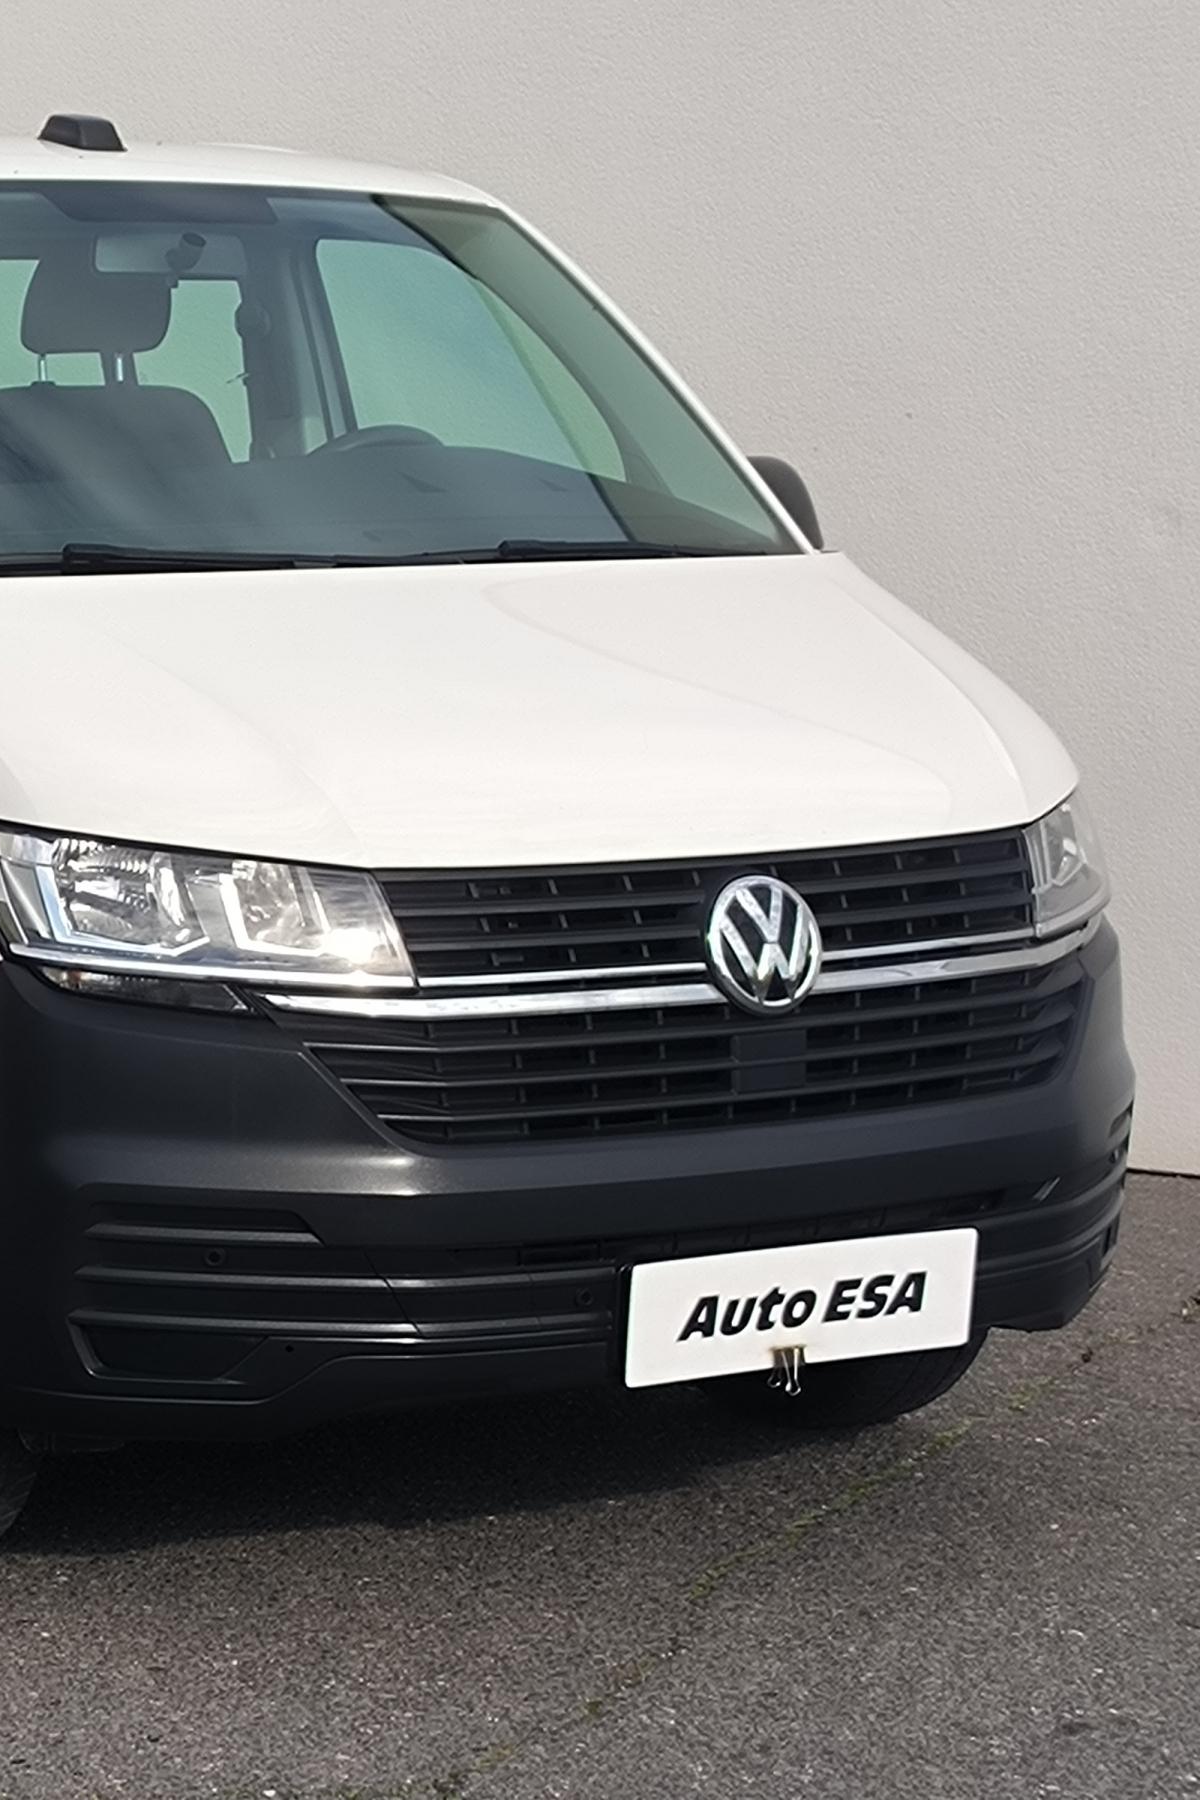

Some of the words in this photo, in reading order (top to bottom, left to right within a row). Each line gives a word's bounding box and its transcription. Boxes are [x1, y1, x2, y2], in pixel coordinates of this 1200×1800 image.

[712, 880, 814, 1004] VW
[677, 1286, 817, 1342] Auto
[822, 1271, 927, 1323] ESA
